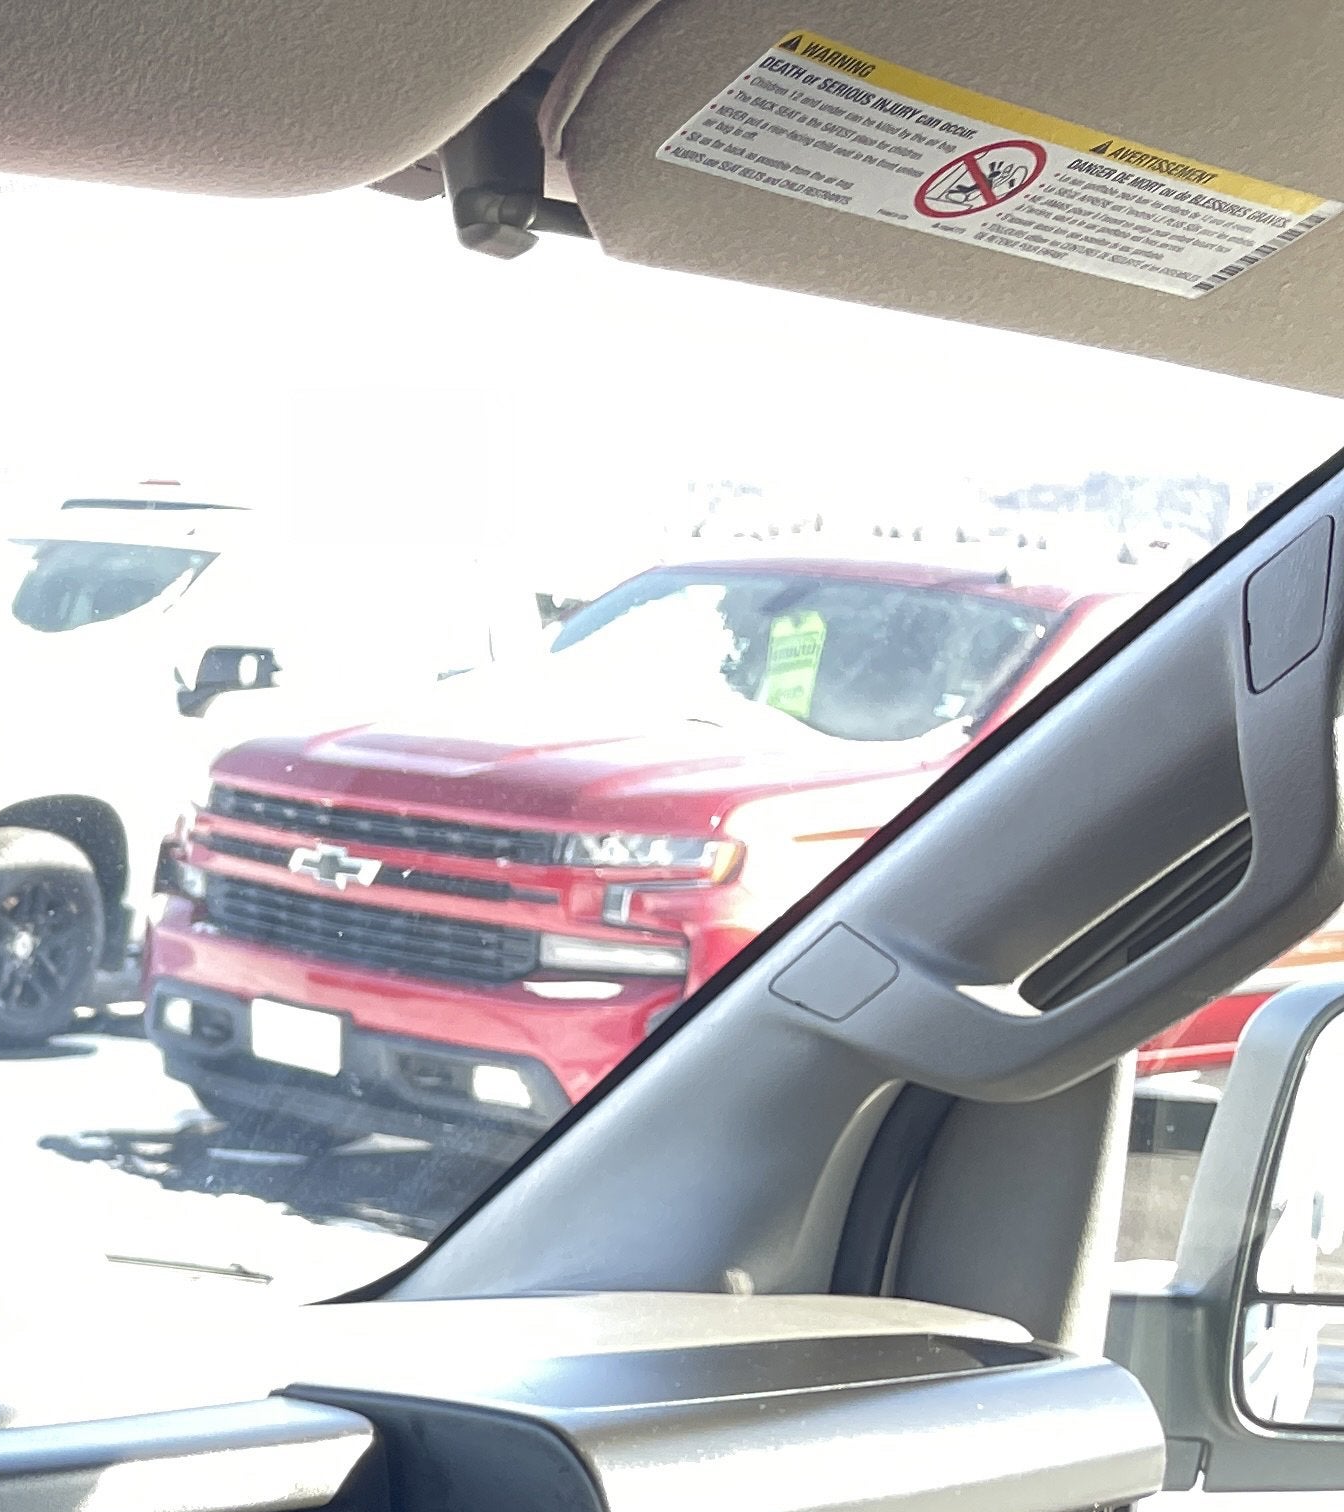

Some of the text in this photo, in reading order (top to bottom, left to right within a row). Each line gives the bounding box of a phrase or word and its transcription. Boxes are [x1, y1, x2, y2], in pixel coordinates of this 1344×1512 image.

[801, 42, 876, 78] WARNING
[759, 56, 978, 140] DEATH or SERIOUS INJURY can occur.
[1067, 159, 1117, 179] DANGER
[1110, 171, 1135, 184] DE
[1127, 176, 1166, 193] MORT
[1108, 147, 1217, 184] AVERTISSEMENT
